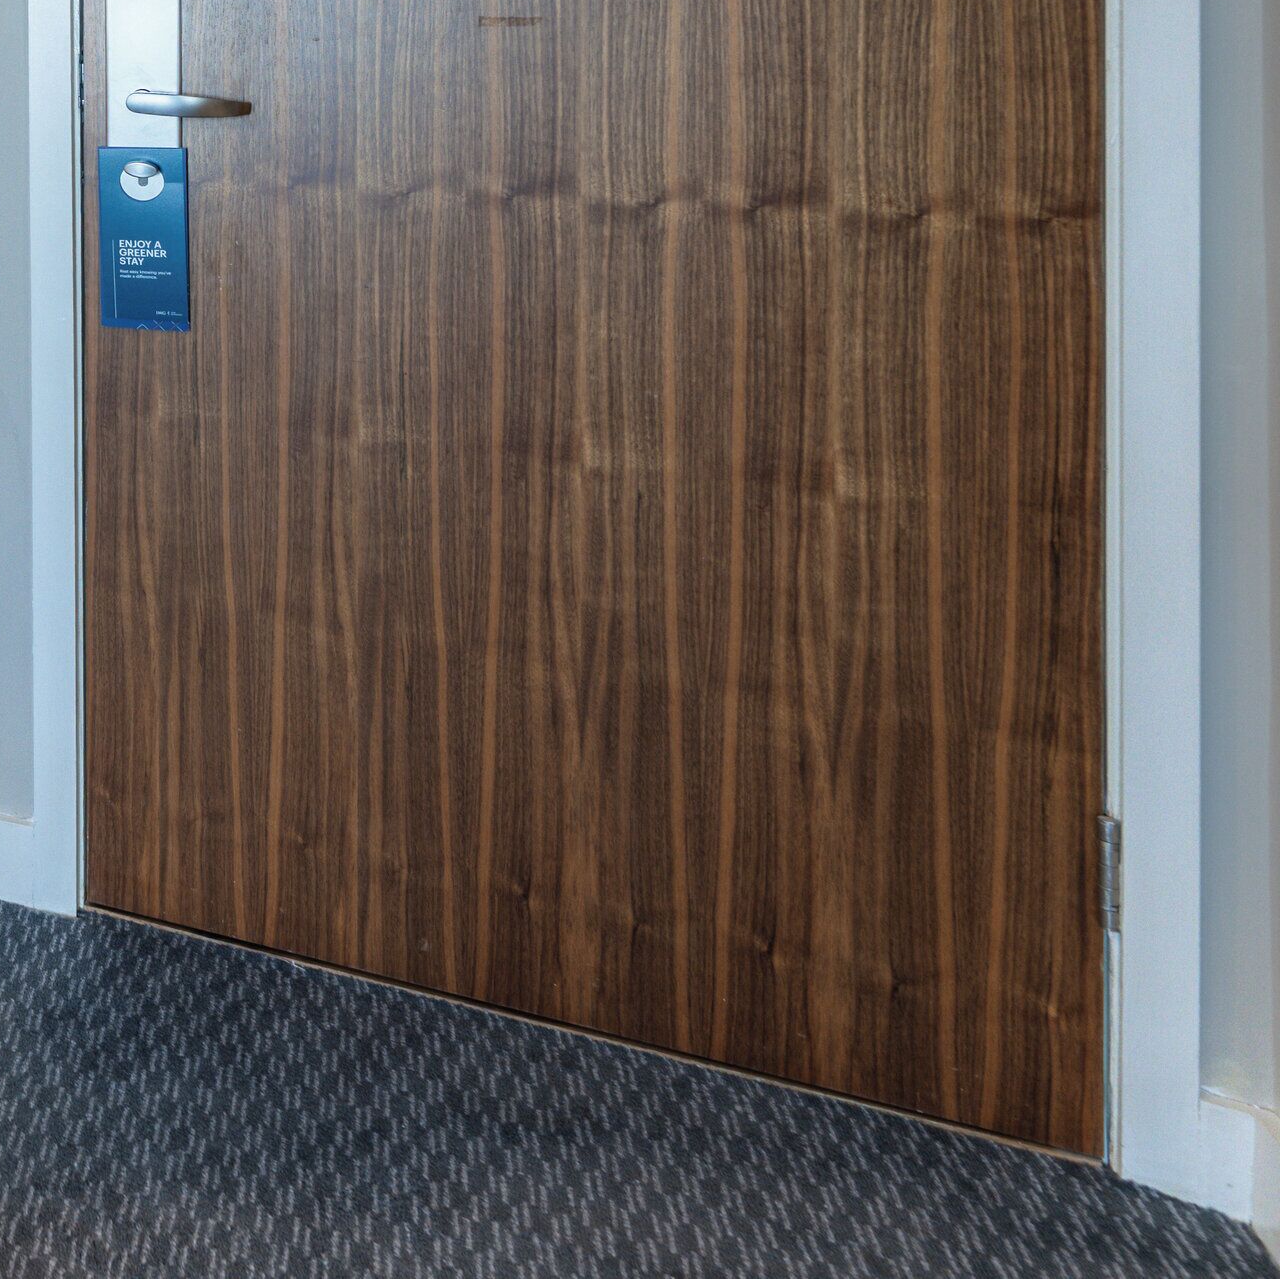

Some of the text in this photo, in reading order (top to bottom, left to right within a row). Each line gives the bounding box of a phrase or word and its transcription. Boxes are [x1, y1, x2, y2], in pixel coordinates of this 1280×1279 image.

[119, 239, 162, 249] ENJOY A
[119, 248, 167, 258] GREENER
[119, 256, 144, 266] STAY
